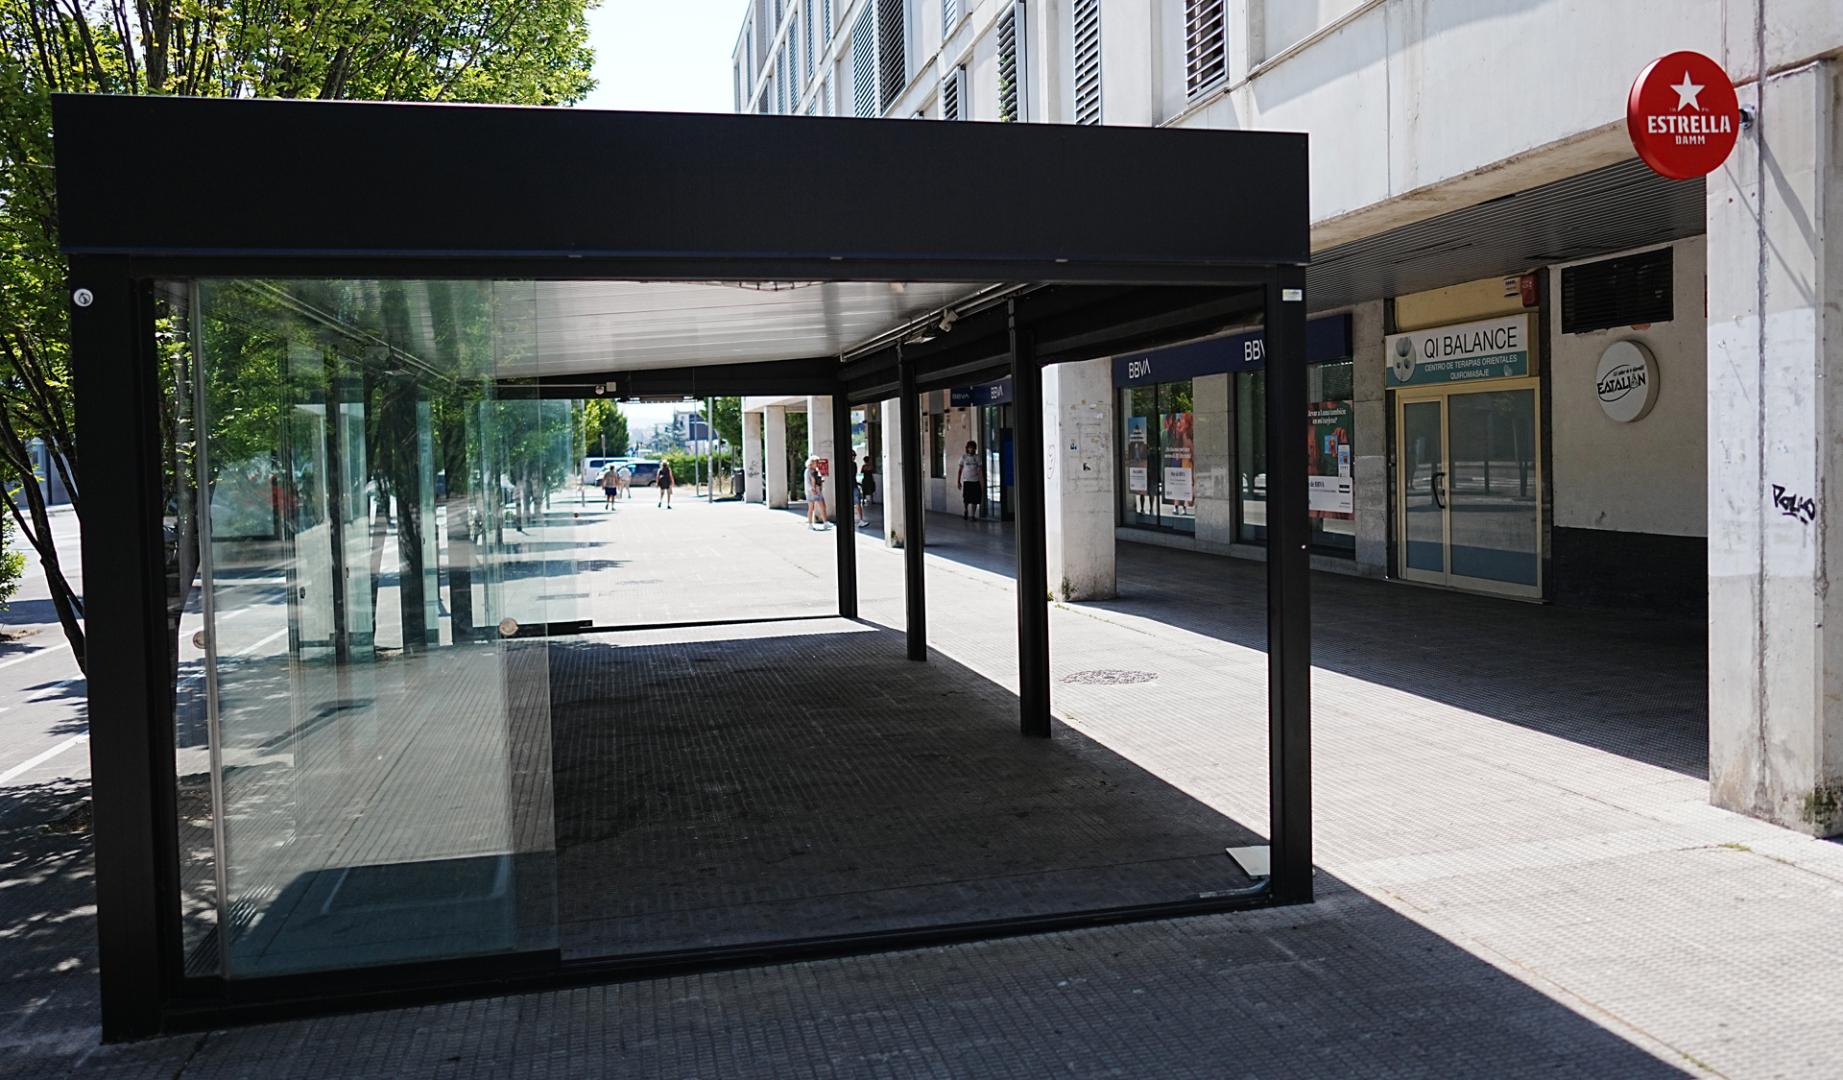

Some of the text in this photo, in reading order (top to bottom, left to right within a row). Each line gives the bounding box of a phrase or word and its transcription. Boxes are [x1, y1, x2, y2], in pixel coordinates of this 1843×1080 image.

[1647, 115, 1731, 134] ESTRELLA
[1675, 135, 1706, 145] DAMM
[1424, 326, 1518, 358] QI BALANCE
[1128, 357, 1151, 378] BBVA
[1424, 354, 1518, 372] CENTRO DE TERAPIAS ORIENTALES
[1450, 368, 1489, 380] QUIROMASAJE
